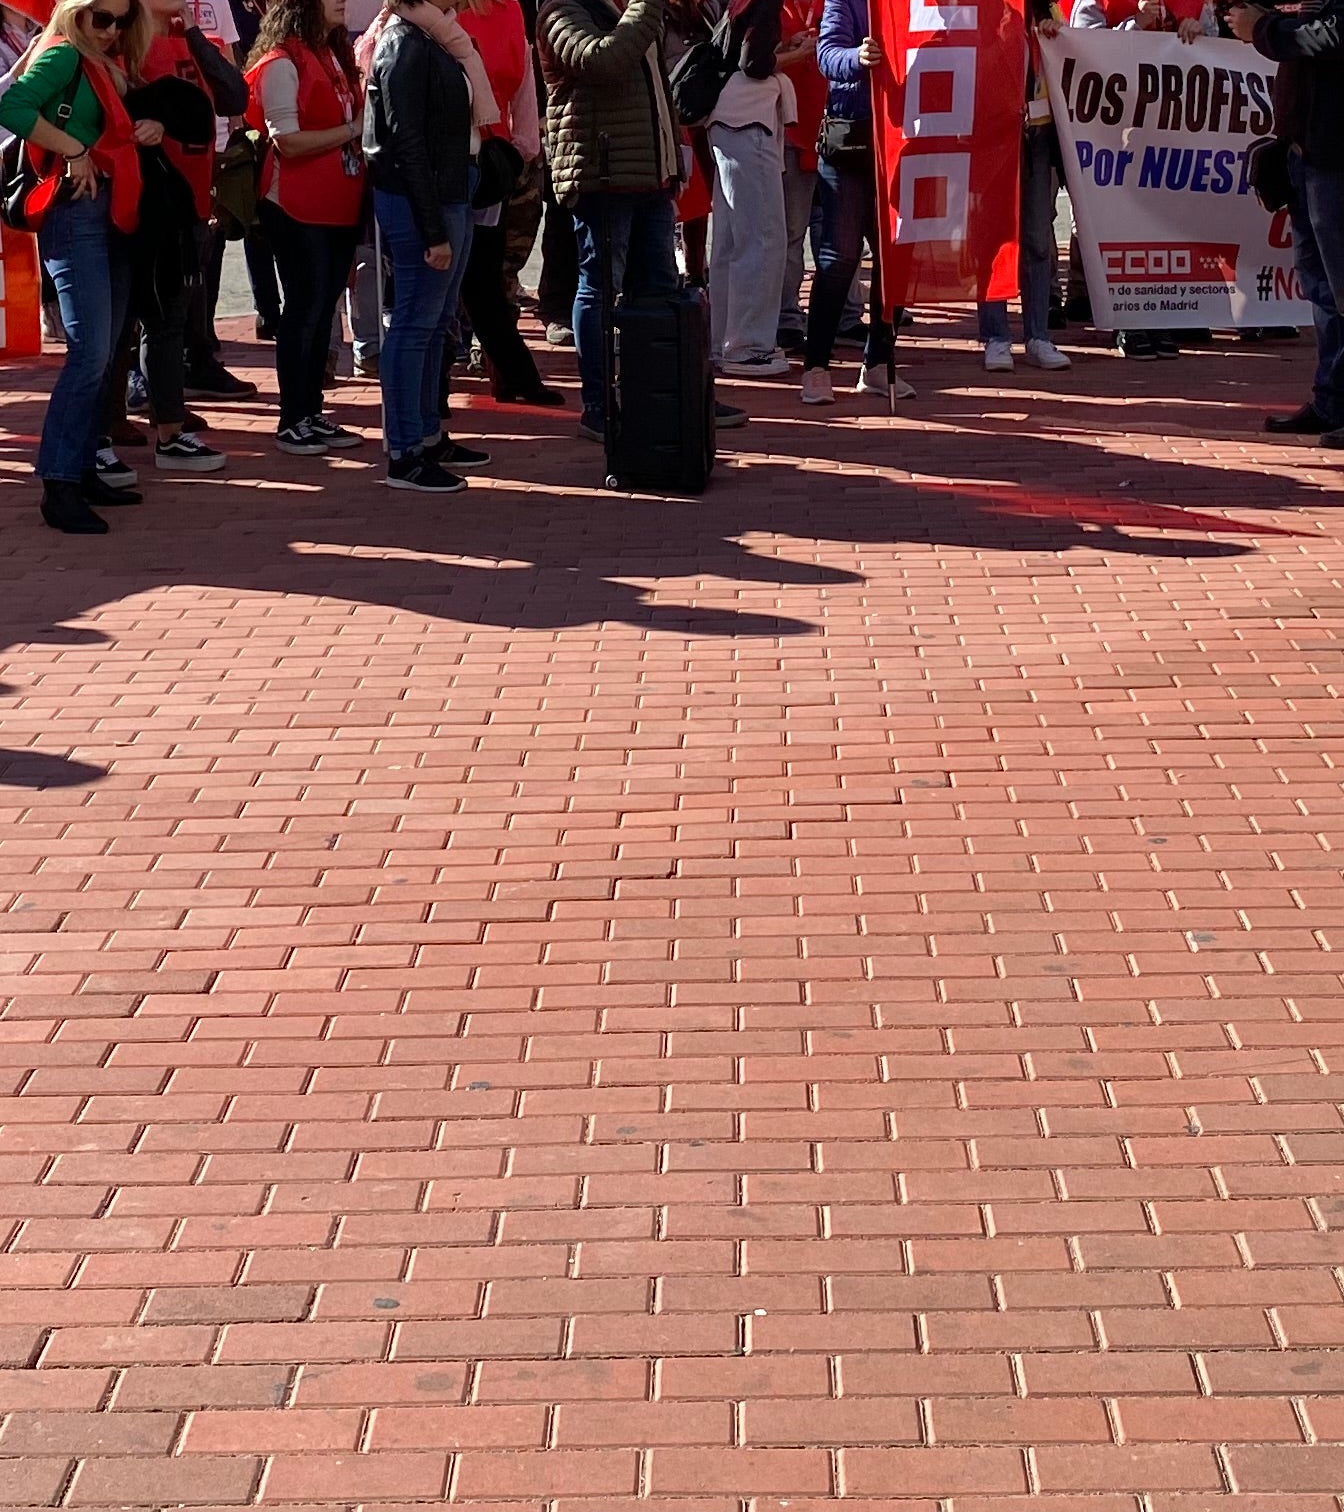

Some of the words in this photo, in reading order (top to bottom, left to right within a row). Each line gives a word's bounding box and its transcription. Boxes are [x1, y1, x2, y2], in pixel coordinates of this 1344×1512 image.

[1132, 63, 1277, 136] PROFES
[1075, 140, 1133, 187] Por
[1138, 145, 1256, 195] NUEST
[1102, 249, 1192, 276] CCOO
[1118, 285, 1131, 296] de
[1135, 285, 1176, 296] sanidad
[1180, 287, 1187, 298] y
[1189, 285, 1236, 296] sectores
[1143, 301, 1157, 312] de
[1160, 299, 1199, 312] Madrid
